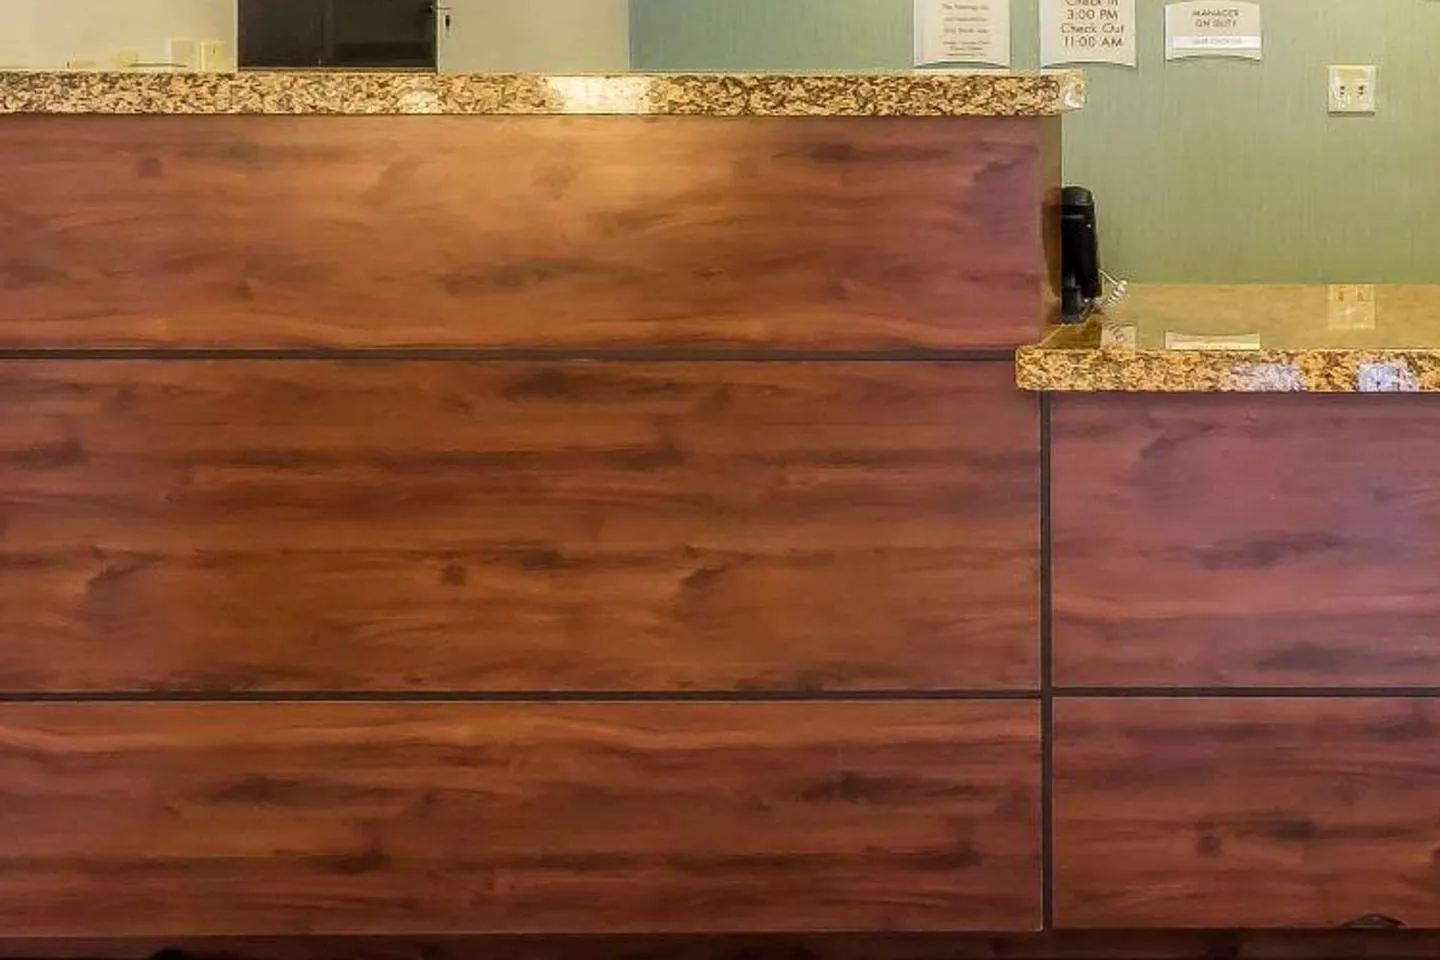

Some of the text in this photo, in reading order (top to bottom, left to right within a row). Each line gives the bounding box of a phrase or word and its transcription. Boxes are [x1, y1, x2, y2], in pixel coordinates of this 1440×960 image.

[1066, 9, 1119, 20] 3:00 PM
[1061, 23, 1097, 34] Check
[1064, 36, 1123, 48] 11:00 AM
